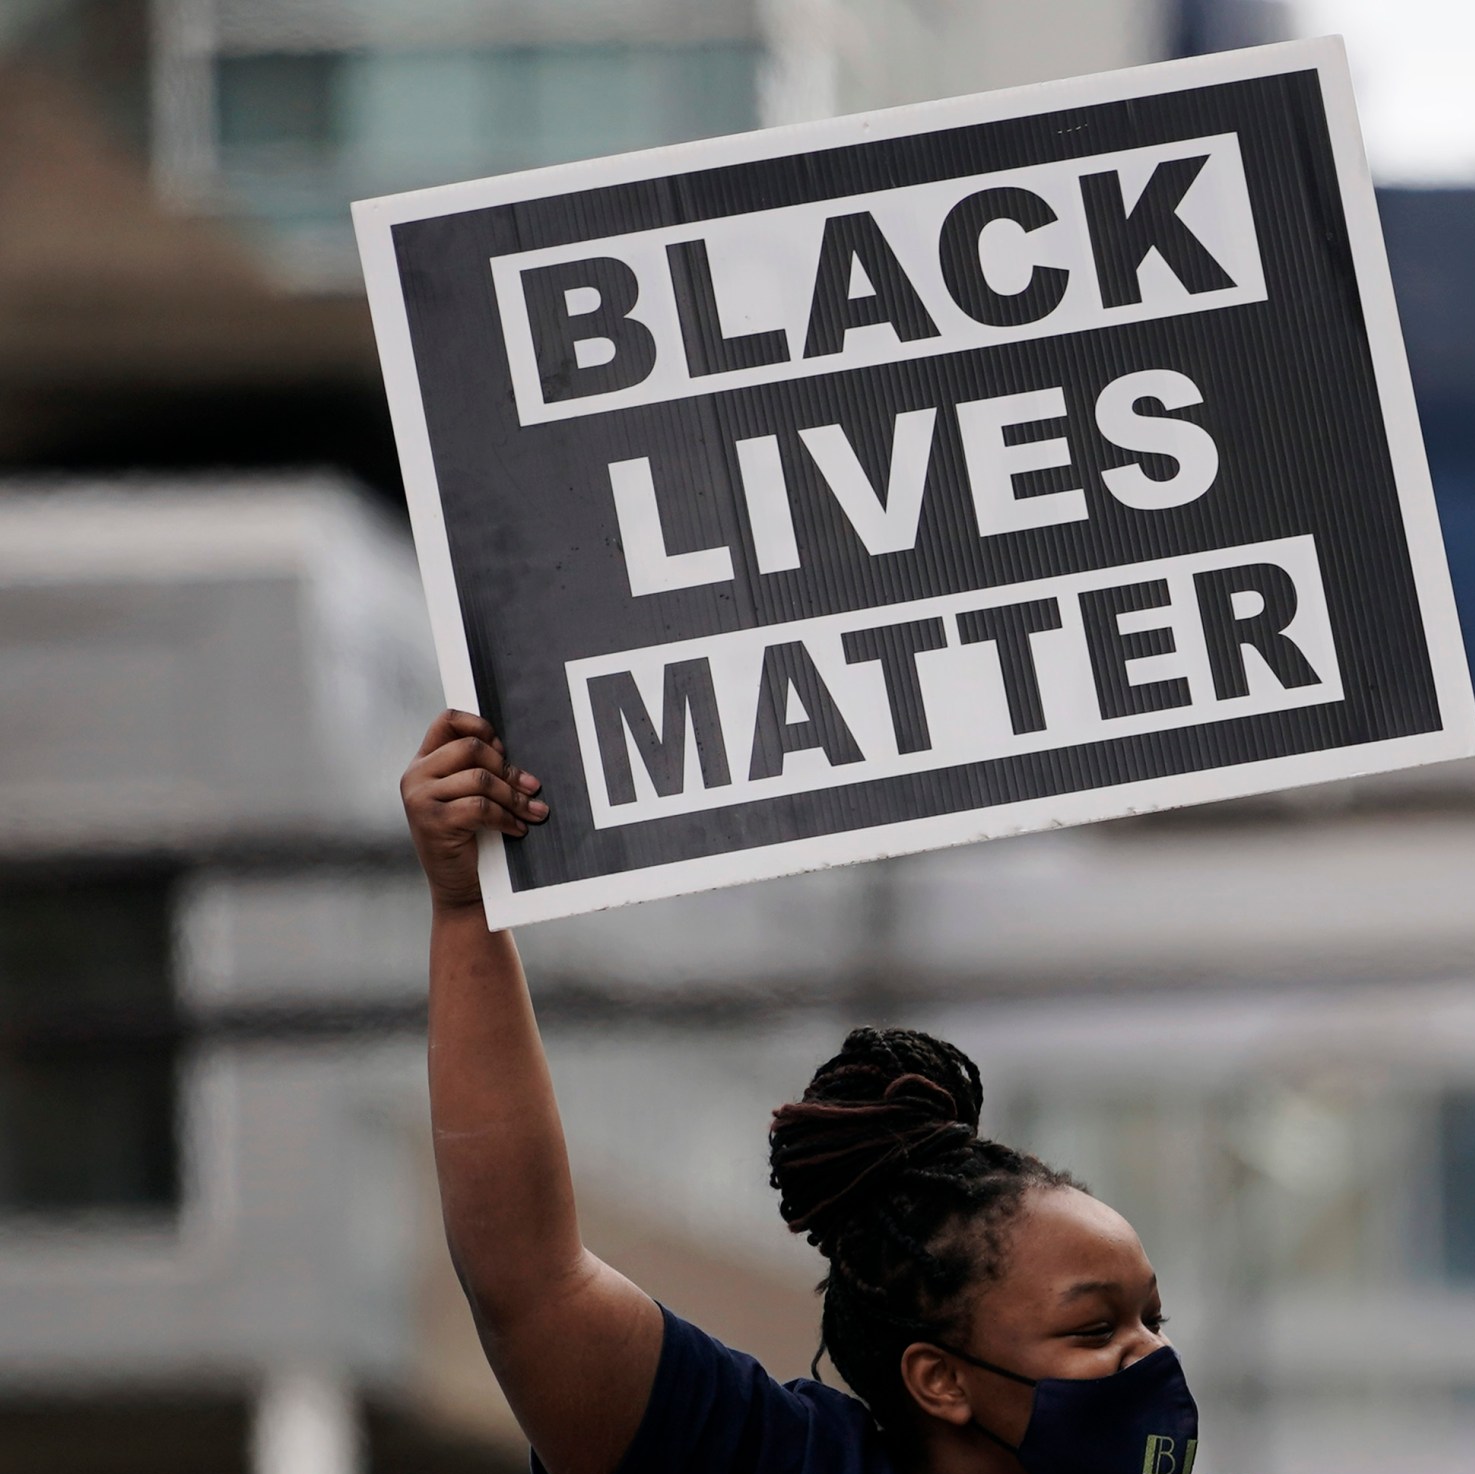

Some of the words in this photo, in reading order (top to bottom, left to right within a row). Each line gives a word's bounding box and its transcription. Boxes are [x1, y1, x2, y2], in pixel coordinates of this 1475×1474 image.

[519, 153, 1239, 405] BLACK
[607, 369, 1220, 597] LIVES
[585, 562, 1324, 807] MATTER
